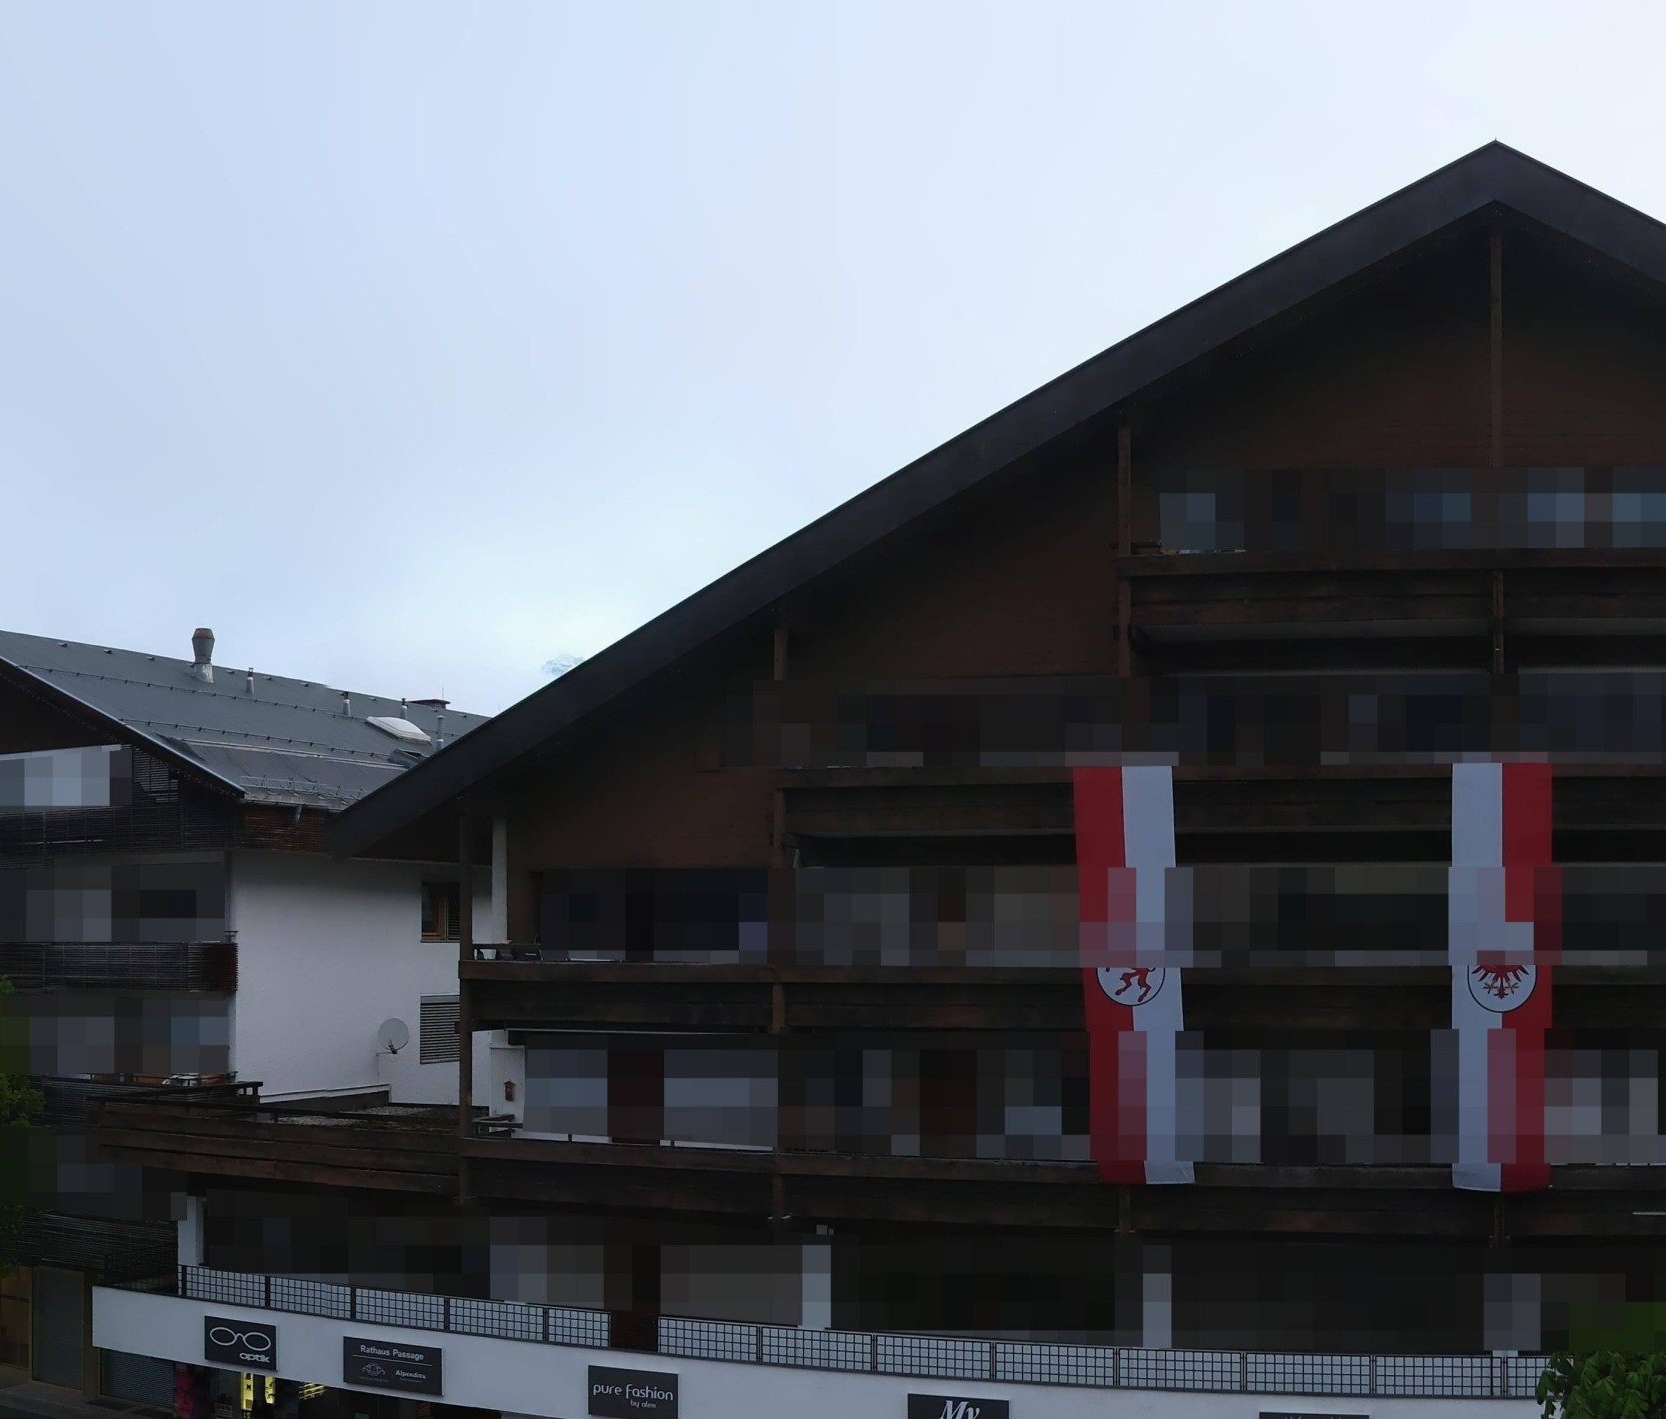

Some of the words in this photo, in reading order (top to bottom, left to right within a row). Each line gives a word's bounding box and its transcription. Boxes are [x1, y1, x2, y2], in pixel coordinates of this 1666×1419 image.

[360, 1344, 391, 1357] Rathaus
[392, 1348, 425, 1362] Passage
[593, 1384, 623, 1396] pure
[625, 1383, 674, 1401] fashion
[630, 1399, 640, 1409] by
